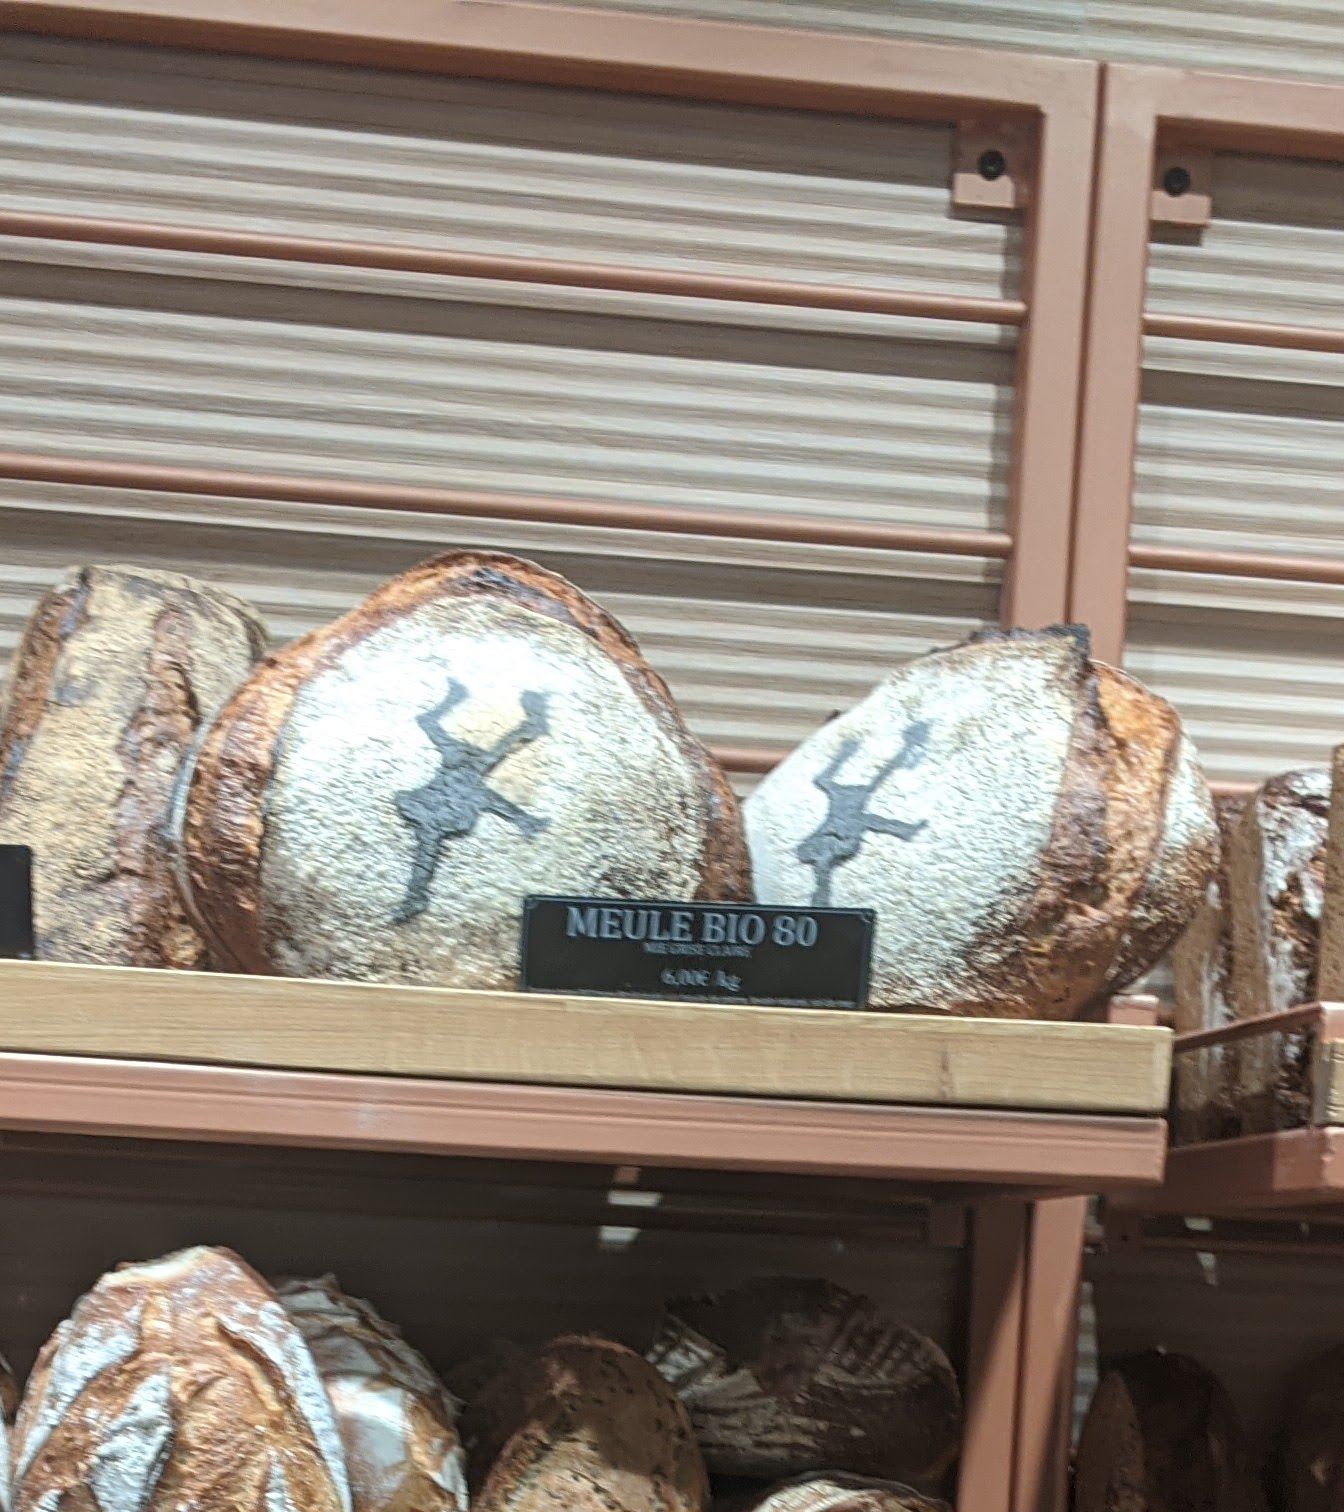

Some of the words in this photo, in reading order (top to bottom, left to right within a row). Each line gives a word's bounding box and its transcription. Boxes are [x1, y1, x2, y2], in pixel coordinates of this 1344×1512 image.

[565, 906, 695, 942] MEULE
[701, 912, 767, 946] BIO
[771, 914, 820, 948] 80
